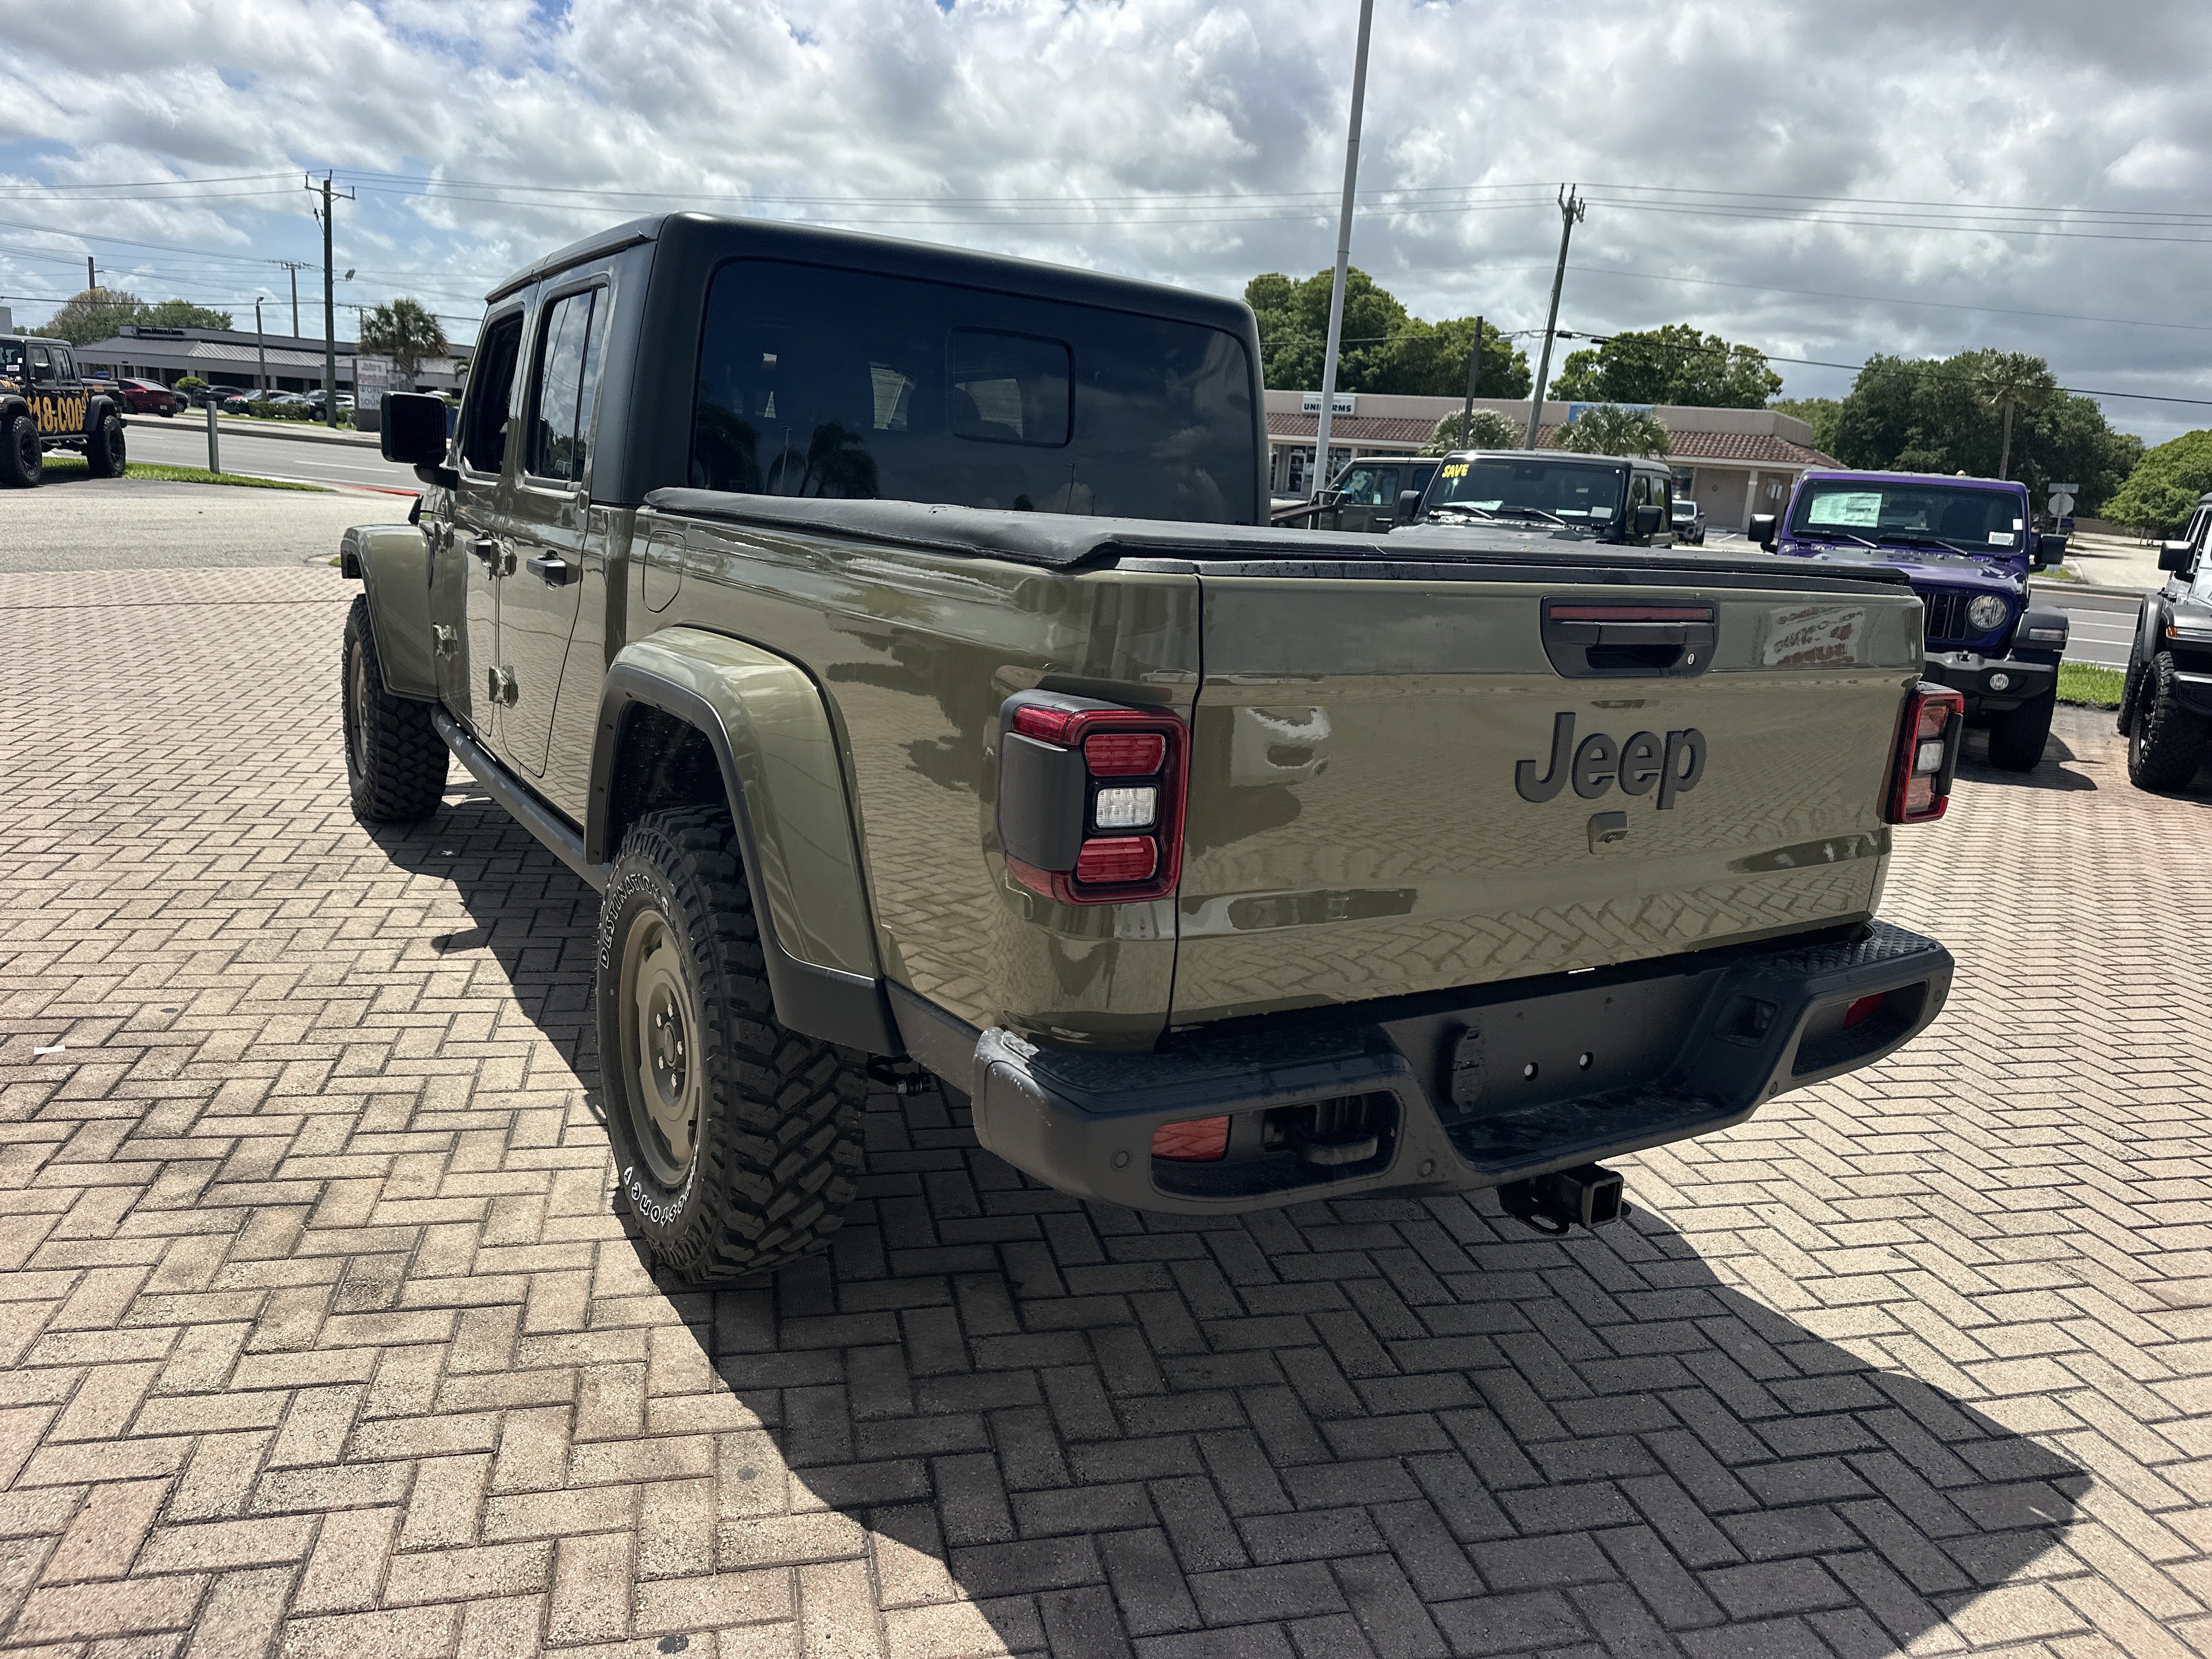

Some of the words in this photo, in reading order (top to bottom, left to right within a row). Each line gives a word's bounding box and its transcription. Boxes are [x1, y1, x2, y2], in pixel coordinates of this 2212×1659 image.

[360, 398, 382, 406] SOUN
[1304, 403, 1351, 412] UNIRMS
[1441, 464, 1470, 478] SAVE
[1515, 712, 1707, 810] Jeep
[600, 873, 662, 969] DESTINATION
